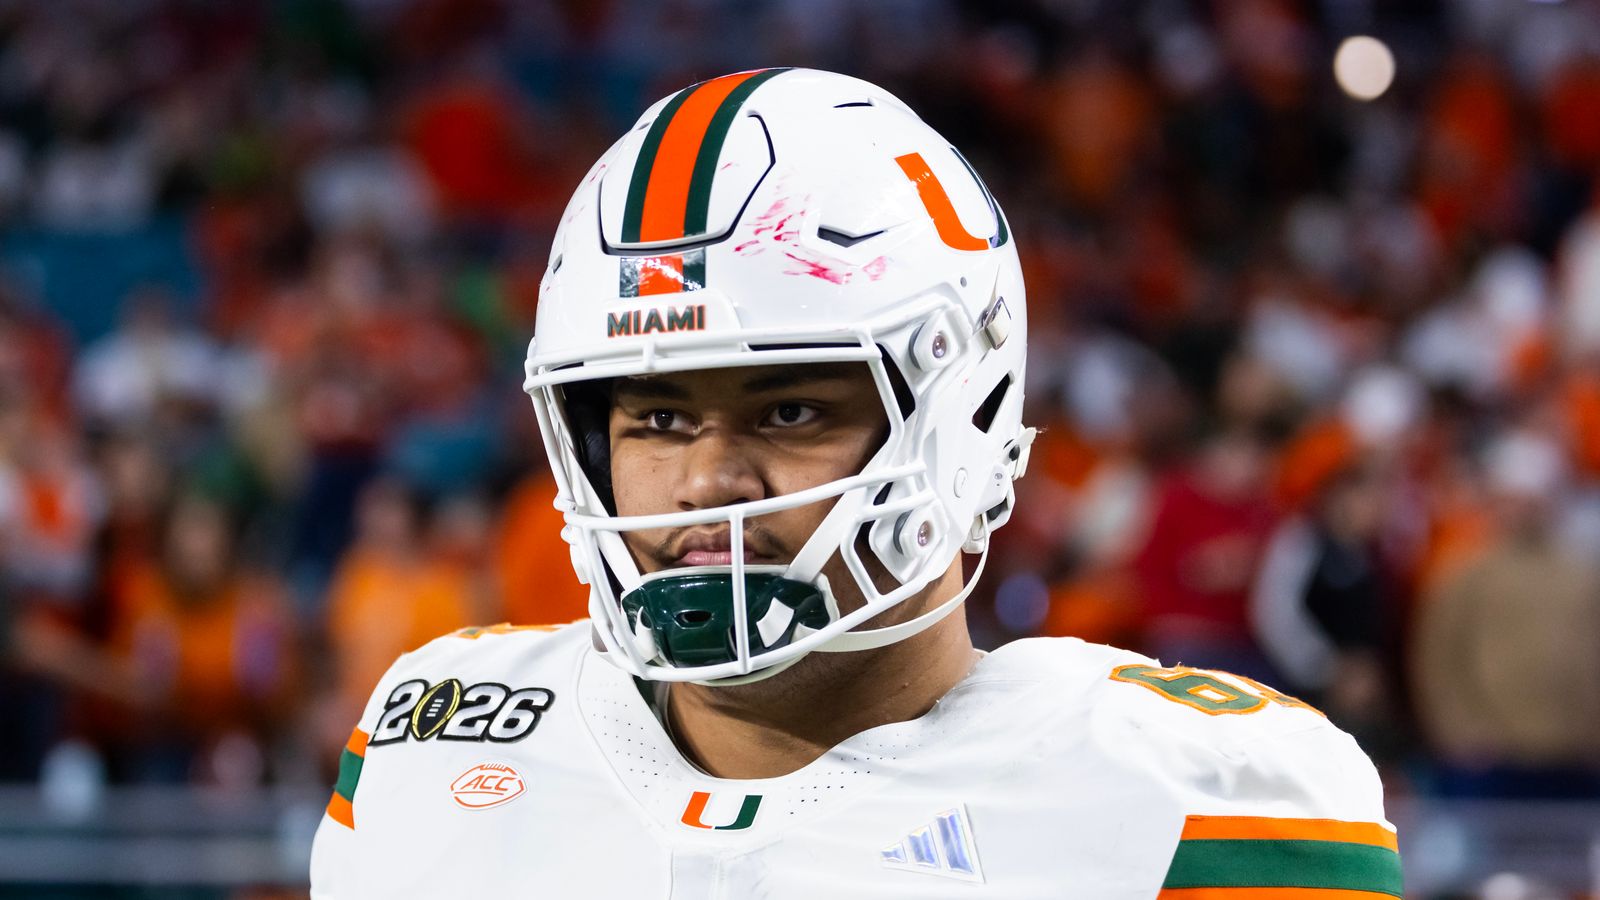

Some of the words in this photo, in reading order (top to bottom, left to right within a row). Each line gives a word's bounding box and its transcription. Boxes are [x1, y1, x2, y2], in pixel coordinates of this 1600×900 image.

[894, 147, 1008, 251] U
[607, 304, 706, 338] MIAMI
[367, 678, 556, 747] 2026
[460, 775, 516, 791] ACC
[681, 791, 763, 830] U
